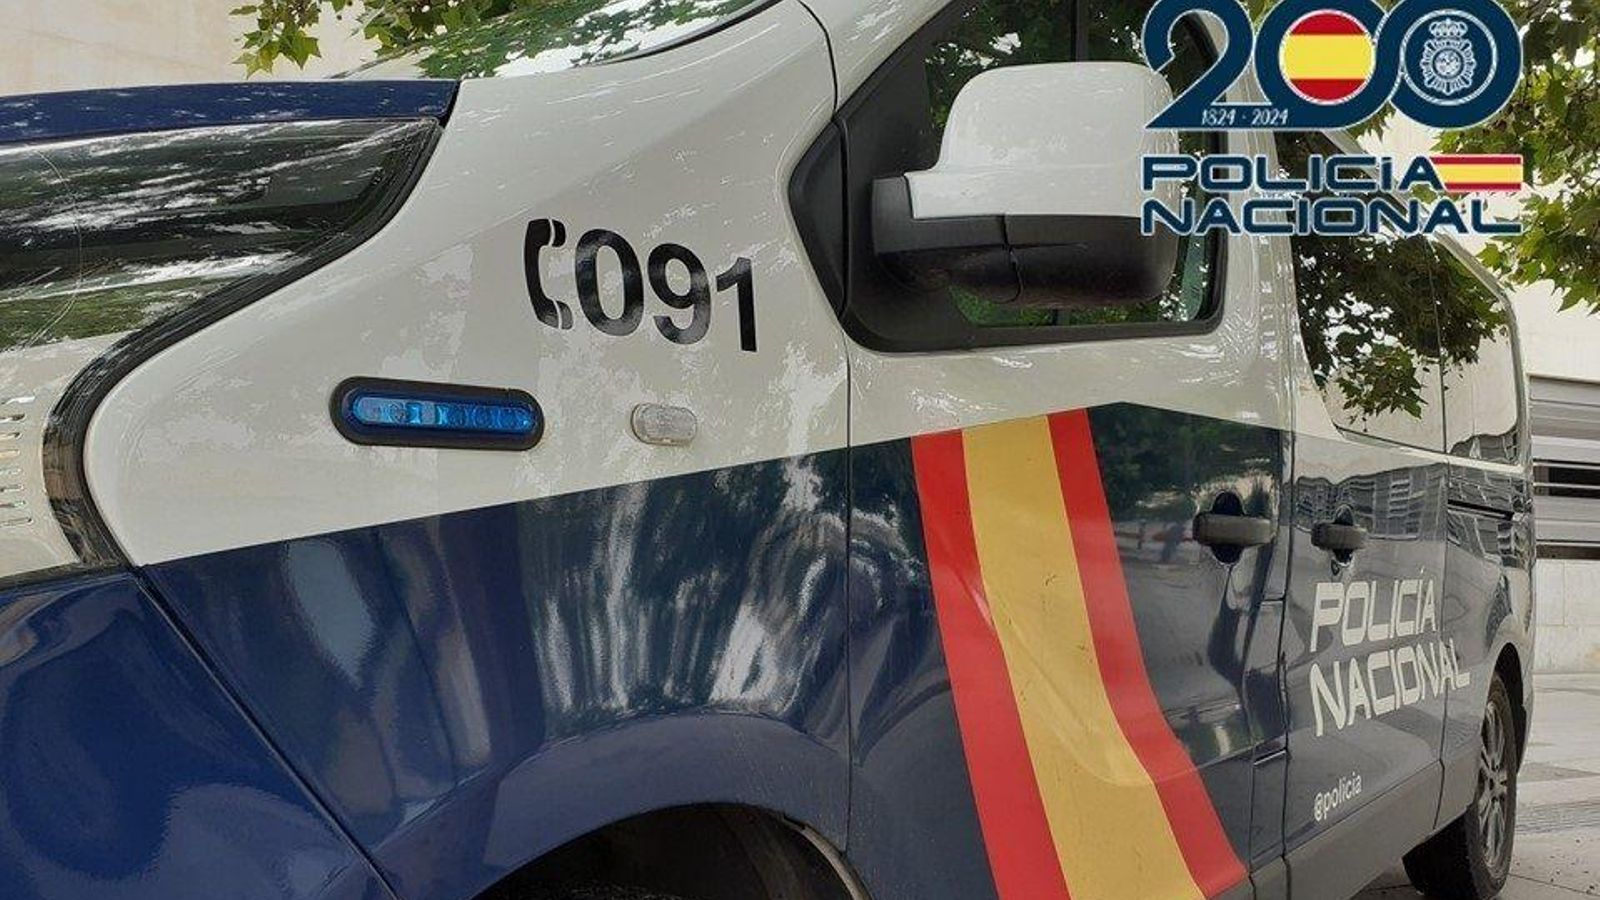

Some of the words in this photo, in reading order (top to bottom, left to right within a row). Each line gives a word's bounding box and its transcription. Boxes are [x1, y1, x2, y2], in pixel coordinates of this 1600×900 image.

[574, 228, 757, 352] 091
[1310, 637, 1471, 737] NACIONAL
[1313, 771, 1362, 822] @policia
